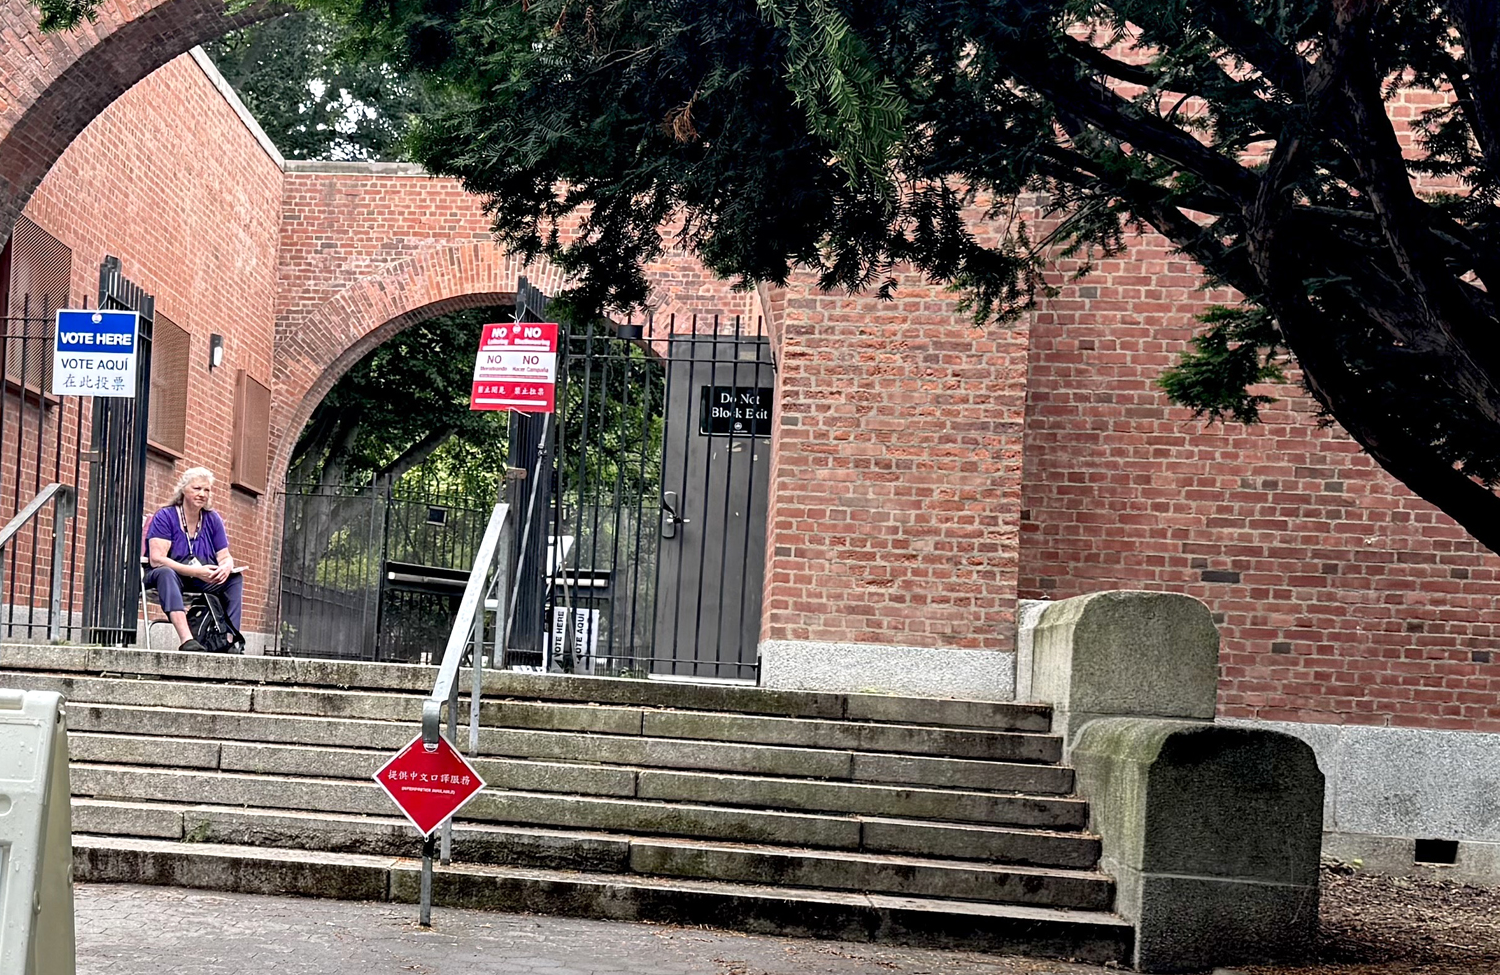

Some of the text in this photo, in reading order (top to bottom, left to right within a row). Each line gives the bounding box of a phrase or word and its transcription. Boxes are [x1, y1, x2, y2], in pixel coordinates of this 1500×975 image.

[60, 332, 132, 346] VOTE HERE
[491, 327, 507, 338] NO
[524, 327, 542, 338] NO
[61, 357, 129, 371] VOTE AQUÍ
[487, 355, 502, 364] NO
[522, 355, 540, 365] NO
[63, 373, 125, 391] 在此投票
[721, 392, 760, 405] Do Not
[556, 611, 564, 634] HERE
[575, 636, 583, 659] OTE
